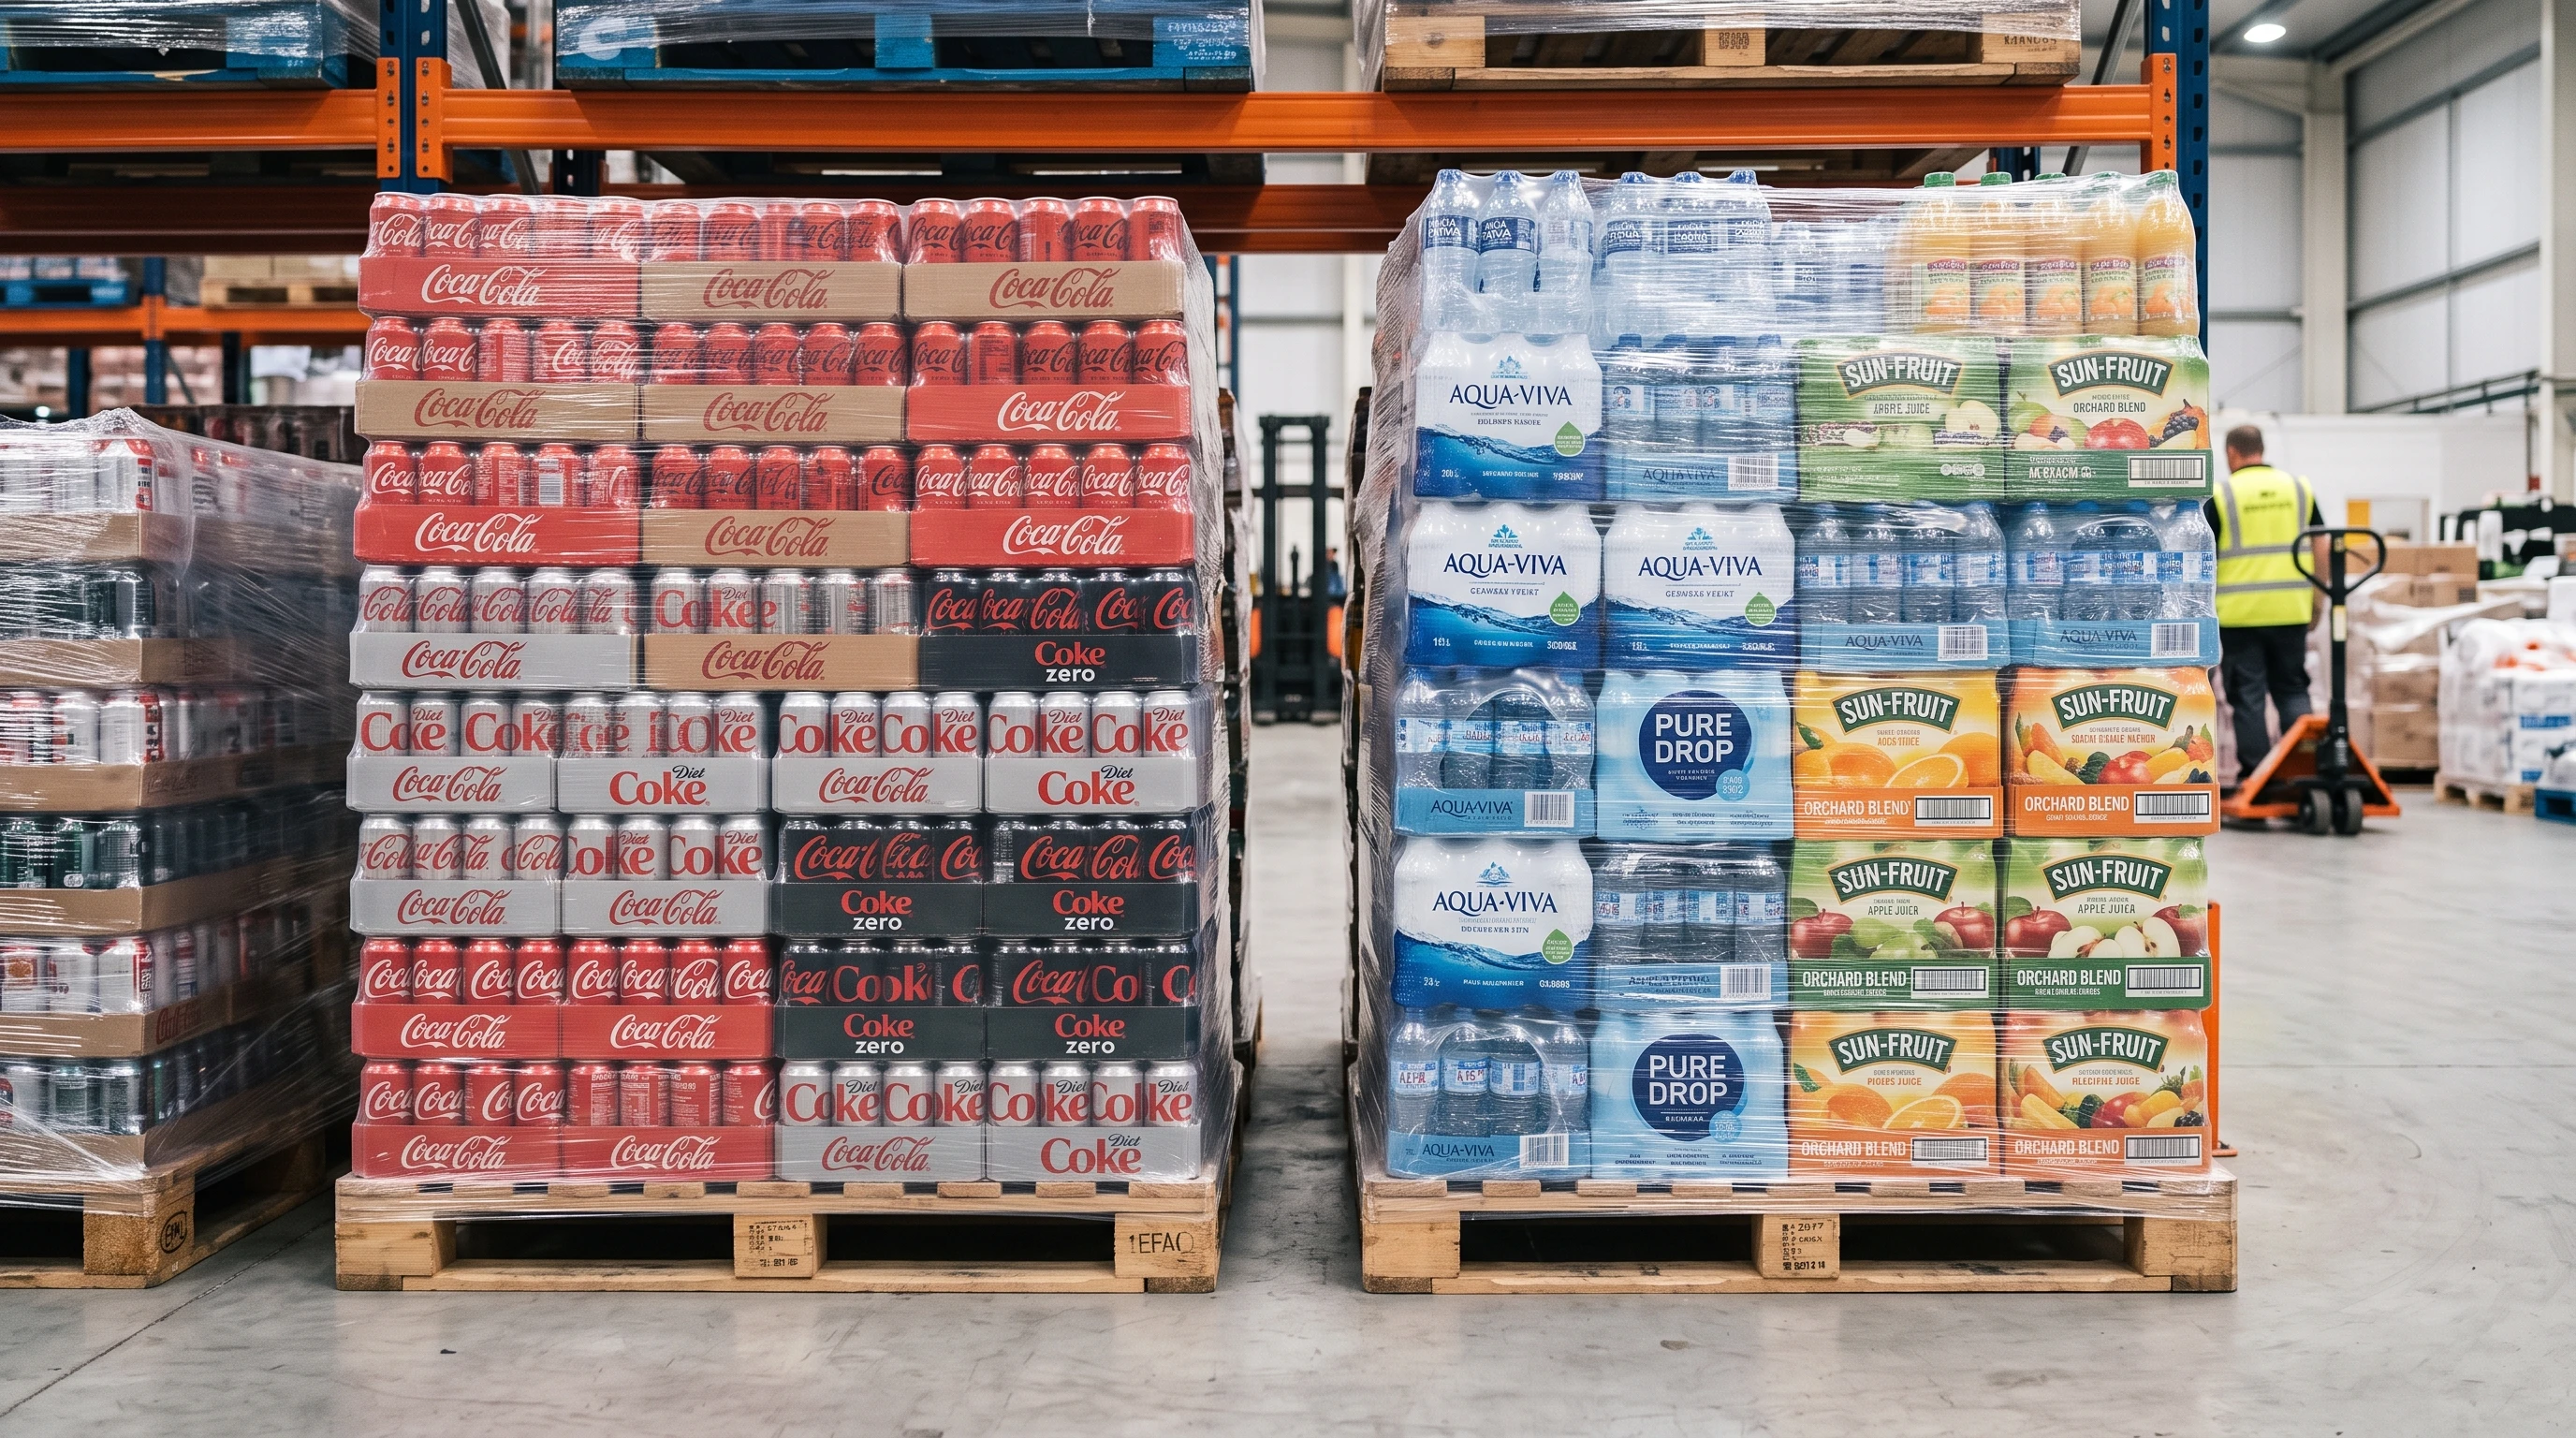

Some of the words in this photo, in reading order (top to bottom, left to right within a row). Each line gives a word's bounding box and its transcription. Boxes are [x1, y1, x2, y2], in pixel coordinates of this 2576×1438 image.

[421, 264, 549, 306] Coca-Cola
[703, 268, 834, 310] Coca-Cola
[989, 267, 1121, 309] Coca-Cola
[1845, 357, 1955, 388] SUN-FRUIT
[2057, 357, 2166, 387] SUN-FRUIT
[415, 387, 546, 430] Coca-Cola
[703, 391, 834, 432] Coca-Cola
[997, 391, 1125, 432] Coca-Cola
[1449, 384, 1573, 409] AQUA-VIVA
[2073, 403, 2115, 413] ORCHARD
[2118, 403, 2145, 413] BLEND
[415, 512, 544, 553] Coca-Cola
[704, 516, 836, 556] Coca-Cola
[1003, 515, 1130, 555] Coca-Cola
[1443, 553, 1567, 579] AQUA-VIVA
[1638, 556, 1763, 581] AQUA-VIVA
[402, 640, 527, 680] Coca-Cola
[702, 640, 831, 681] Coca-Cola
[1034, 640, 1105, 666] Coke
[1046, 667, 1095, 682] zero
[1841, 687, 1954, 724] SUN-FRUIT
[2060, 684, 2170, 720] SUN-FRUIT
[1655, 713, 1733, 737] PURE
[1655, 741, 1734, 763] DROP
[392, 766, 508, 802] Coca-Cola
[609, 770, 707, 805] Coke
[672, 765, 705, 780] Diet
[819, 767, 935, 803] Coca-Cola
[1038, 770, 1134, 805] Coke
[1101, 765, 1133, 780] Diet
[1805, 800, 1864, 815] ORCHARD
[1868, 800, 1908, 815] BLEND
[2025, 797, 2085, 811] ORCHARD
[2089, 797, 2129, 811] BLEND
[1837, 861, 1950, 894] SUN-FRUIT
[2051, 861, 2164, 893] SUN-FRUIT
[397, 889, 513, 925] Coca-Cola
[609, 889, 724, 925] Coca-Cola
[842, 889, 912, 916] Coke
[1053, 889, 1124, 916] Coke
[1432, 891, 1558, 916] AQUA-VIVA
[1868, 905, 1893, 915] APPLE
[2078, 904, 2105, 914] APPLE
[853, 915, 902, 931] zero
[1064, 915, 1114, 931] zero
[1803, 971, 1862, 987] ORCHARD
[1866, 971, 1906, 987] BLEND
[2017, 970, 2076, 986] ORCHARD
[2081, 970, 2121, 985] BLEND
[401, 1013, 512, 1049] Coca-Cola
[610, 1013, 723, 1049] Coca-Cola
[843, 1013, 915, 1038] Coke
[1054, 1013, 1125, 1038] Coke
[855, 1039, 904, 1054] zero
[1065, 1039, 1115, 1054] zero
[1837, 1033, 1948, 1064] SUN-FRUIT
[2052, 1032, 2161, 1063] SUN-FRUIT
[1649, 1055, 1726, 1078] PURE
[1649, 1083, 1728, 1105] DROP
[401, 1135, 513, 1170] Coca-Cola
[610, 1135, 722, 1170] Coca-Cola
[821, 1136, 936, 1171] Coca-Cola
[1040, 1137, 1142, 1174] Coke
[1423, 1143, 1494, 1158] AQUA-VIVA
[1802, 1140, 1862, 1157] ORCHARD
[1866, 1140, 1907, 1156] BLEND
[2015, 1140, 2075, 1156] ORCHARD
[2079, 1139, 2119, 1154] BLEND
